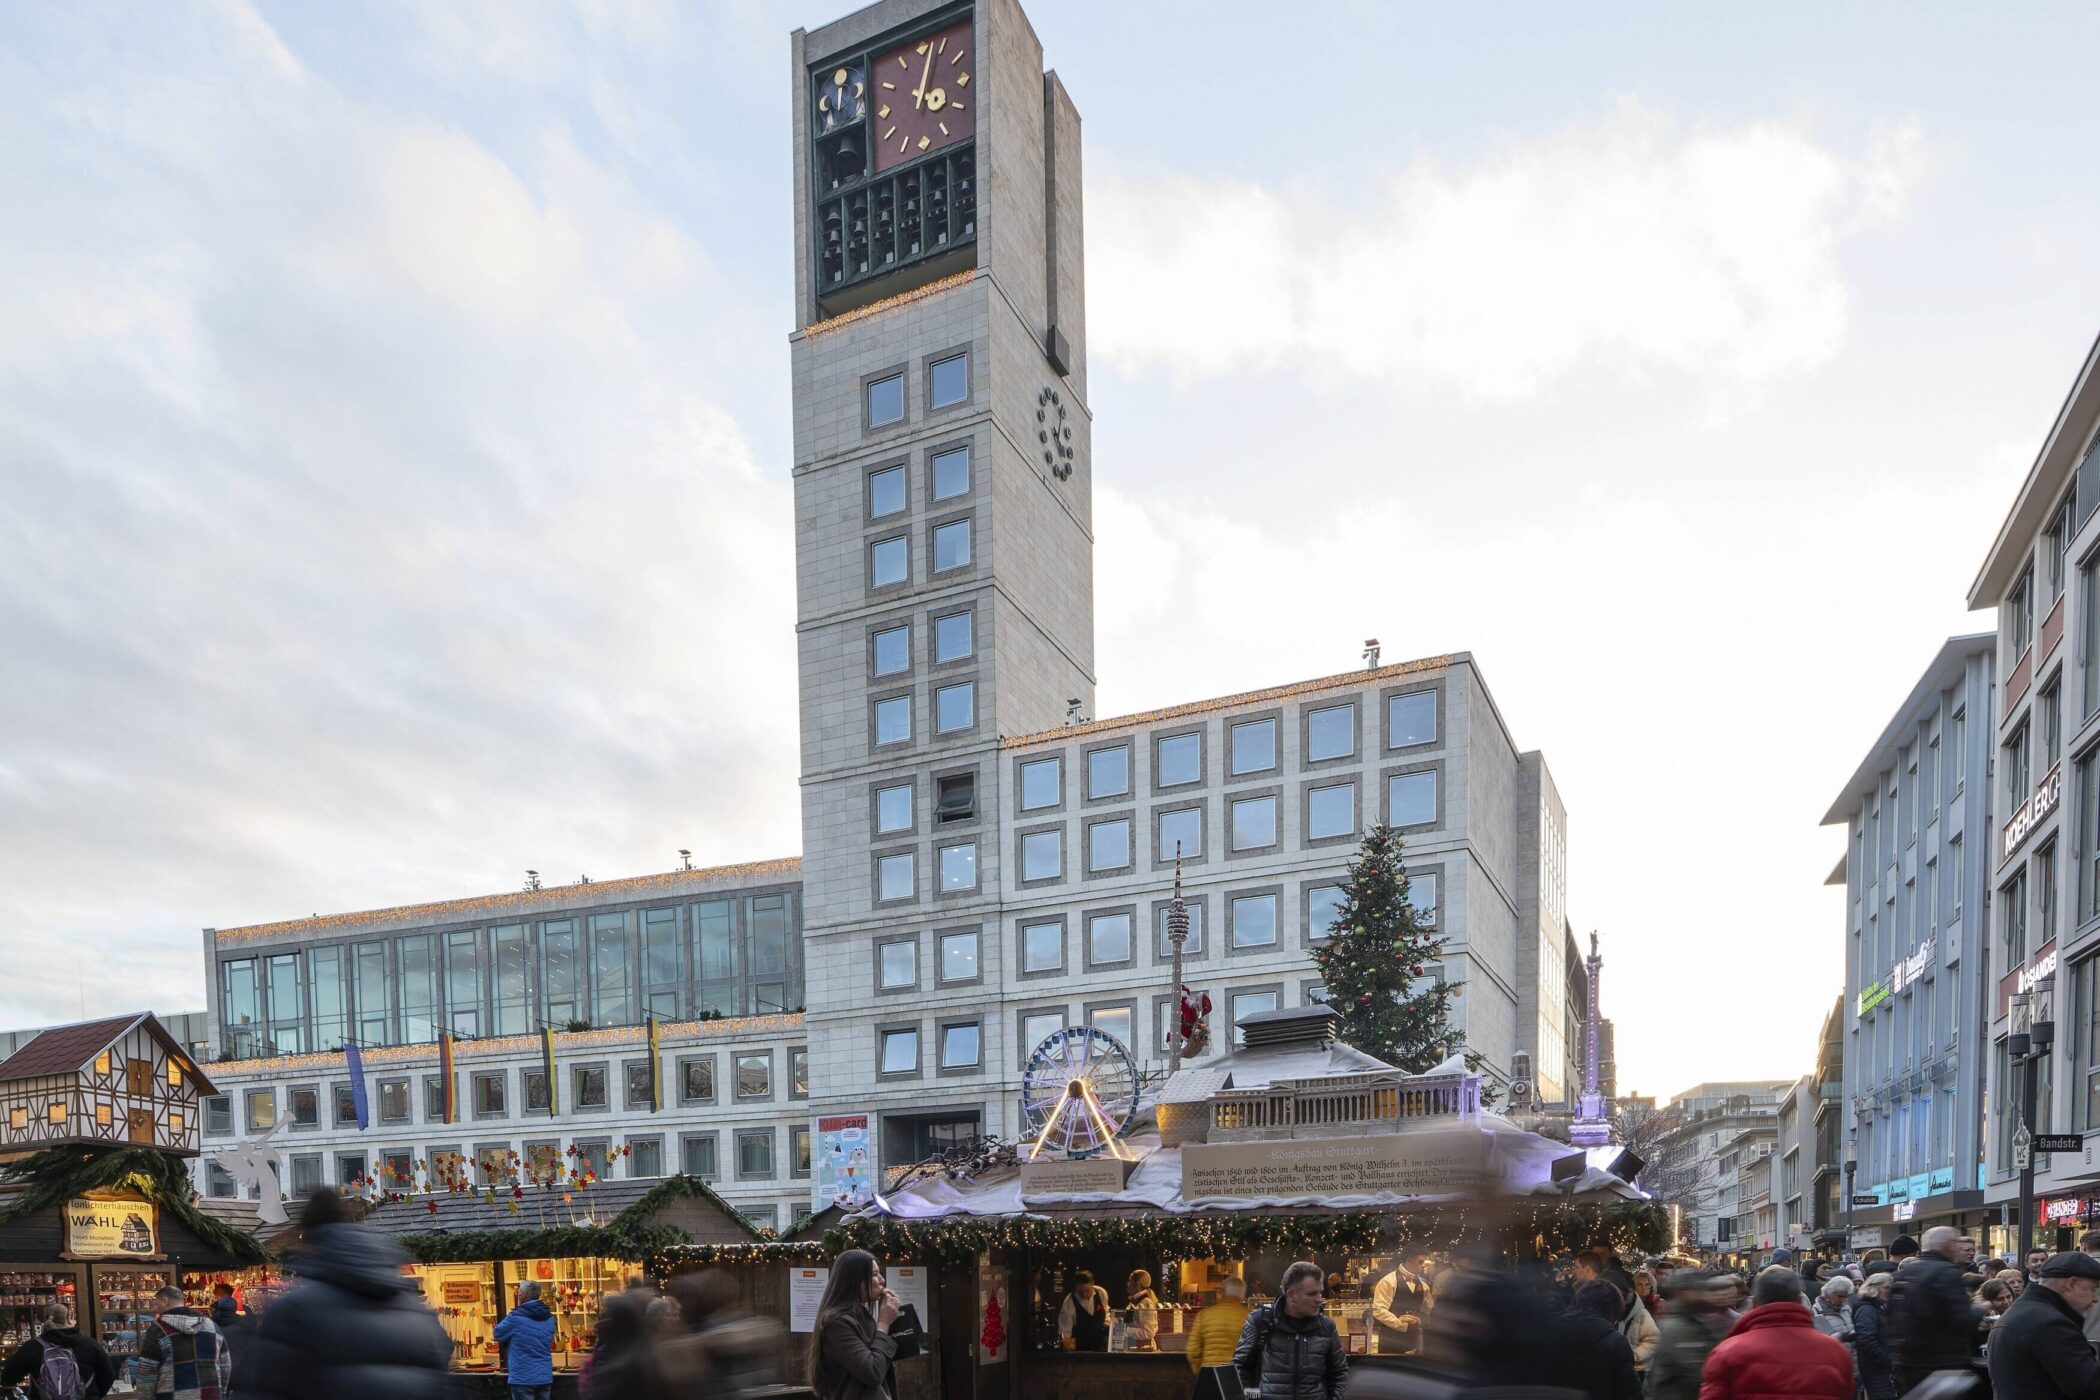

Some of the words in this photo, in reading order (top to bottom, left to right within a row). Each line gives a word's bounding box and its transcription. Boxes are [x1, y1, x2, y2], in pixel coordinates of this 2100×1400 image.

[2040, 1138, 2078, 1149] Bandstr.
[2016, 1147, 2026, 1159] WC
[1192, 1168, 1225, 1178] Zwischen
[1244, 1166, 1258, 1175] und
[1260, 1166, 1276, 1175] 1860
[1278, 1166, 1289, 1174] im
[1293, 1164, 1321, 1174] Auftrag
[1323, 1164, 1337, 1172] von
[1340, 1162, 1363, 1171] König
[1365, 1160, 1400, 1171] Wilhelm
[1411, 1159, 1422, 1168] im
[1194, 1178, 1228, 1188] zistischen
[1230, 1176, 1245, 1185] Stil
[1247, 1176, 1258, 1184] als
[1305, 1174, 1338, 1183] Konzert-
[1341, 1172, 1355, 1180] und
[1358, 1169, 1394, 1179] Ballhaus
[1397, 1168, 1431, 1178] errichtet.
[1195, 1186, 1222, 1197] nigsbau
[1223, 1186, 1233, 1195] ist
[1235, 1186, 1253, 1194] eines
[1254, 1185, 1266, 1194] der
[1267, 1184, 1304, 1196] prägenden
[1306, 1182, 1339, 1192] Gebäude
[1340, 1181, 1353, 1191] des
[1356, 1180, 1401, 1190] Stuttgarter
[71, 1215, 120, 1228] WAHL
